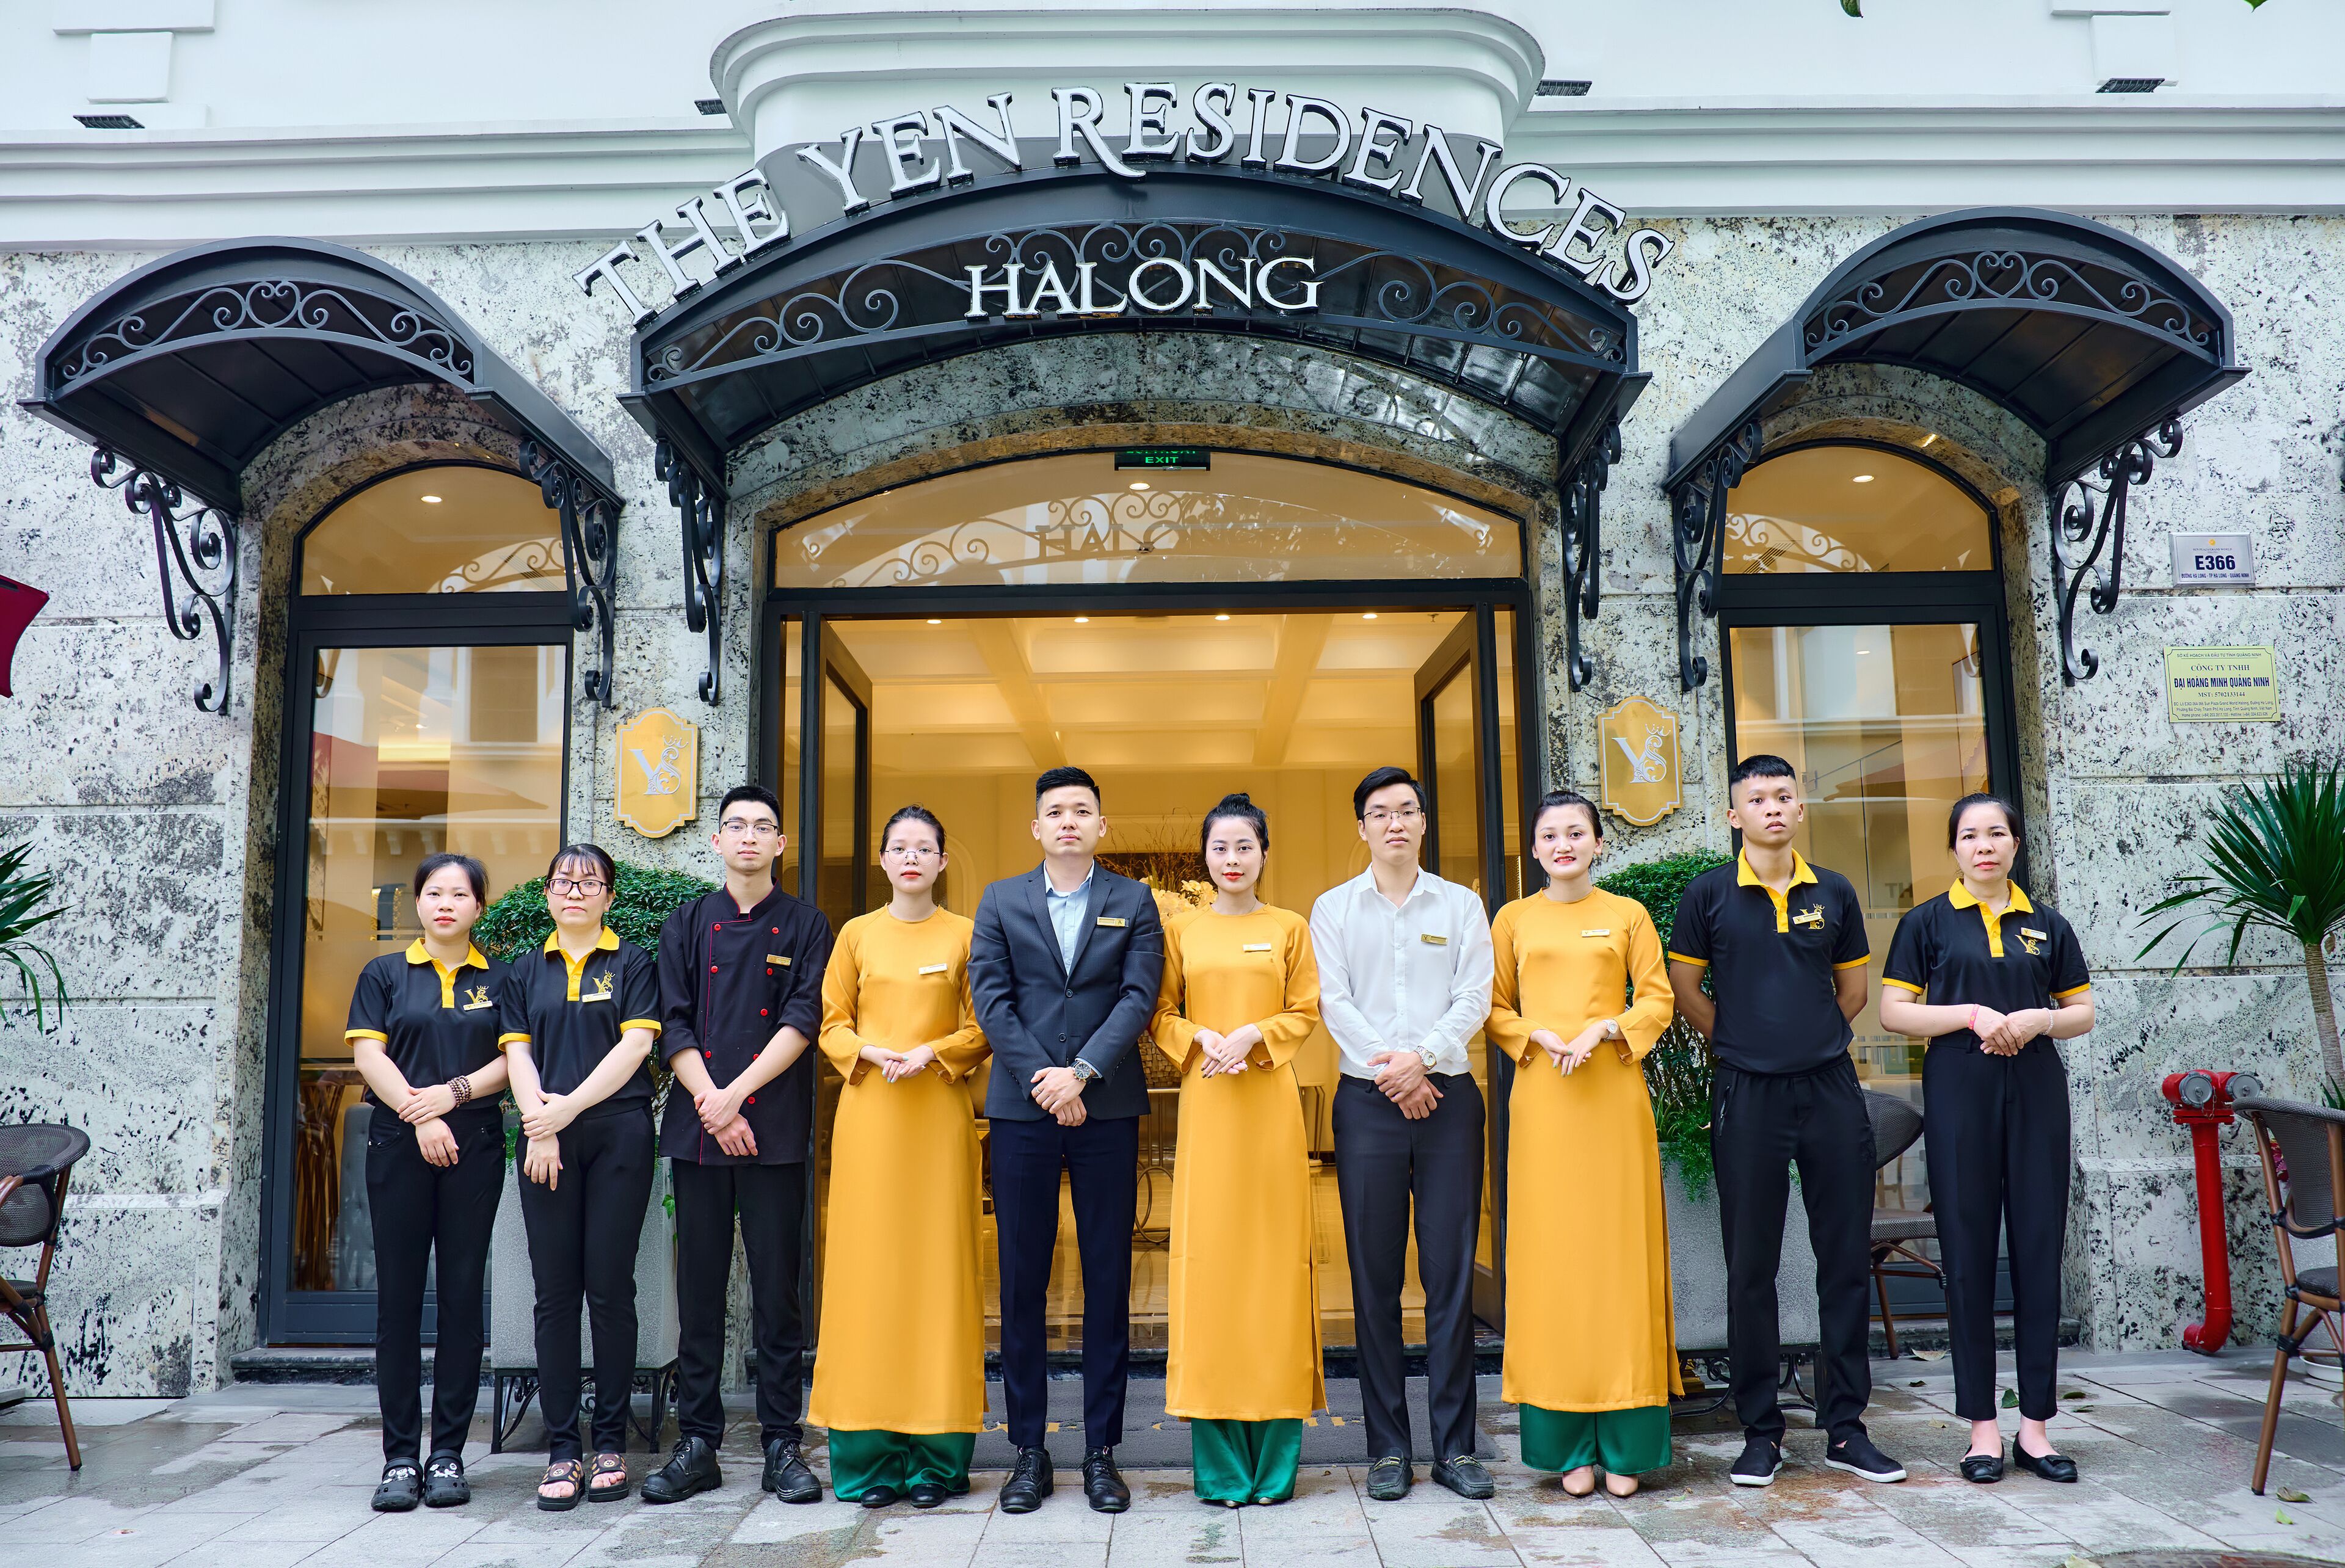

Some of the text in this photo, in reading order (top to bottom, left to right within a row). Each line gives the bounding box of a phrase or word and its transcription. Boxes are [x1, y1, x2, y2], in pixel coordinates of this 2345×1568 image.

[572, 81, 1675, 330] THE YEN RESIDENCES
[965, 256, 1324, 321] HALONG
[2195, 555, 2236, 570] E366
[2175, 674, 2269, 690] ĐẠI HOÀNG MINH QUẢNG NINH
